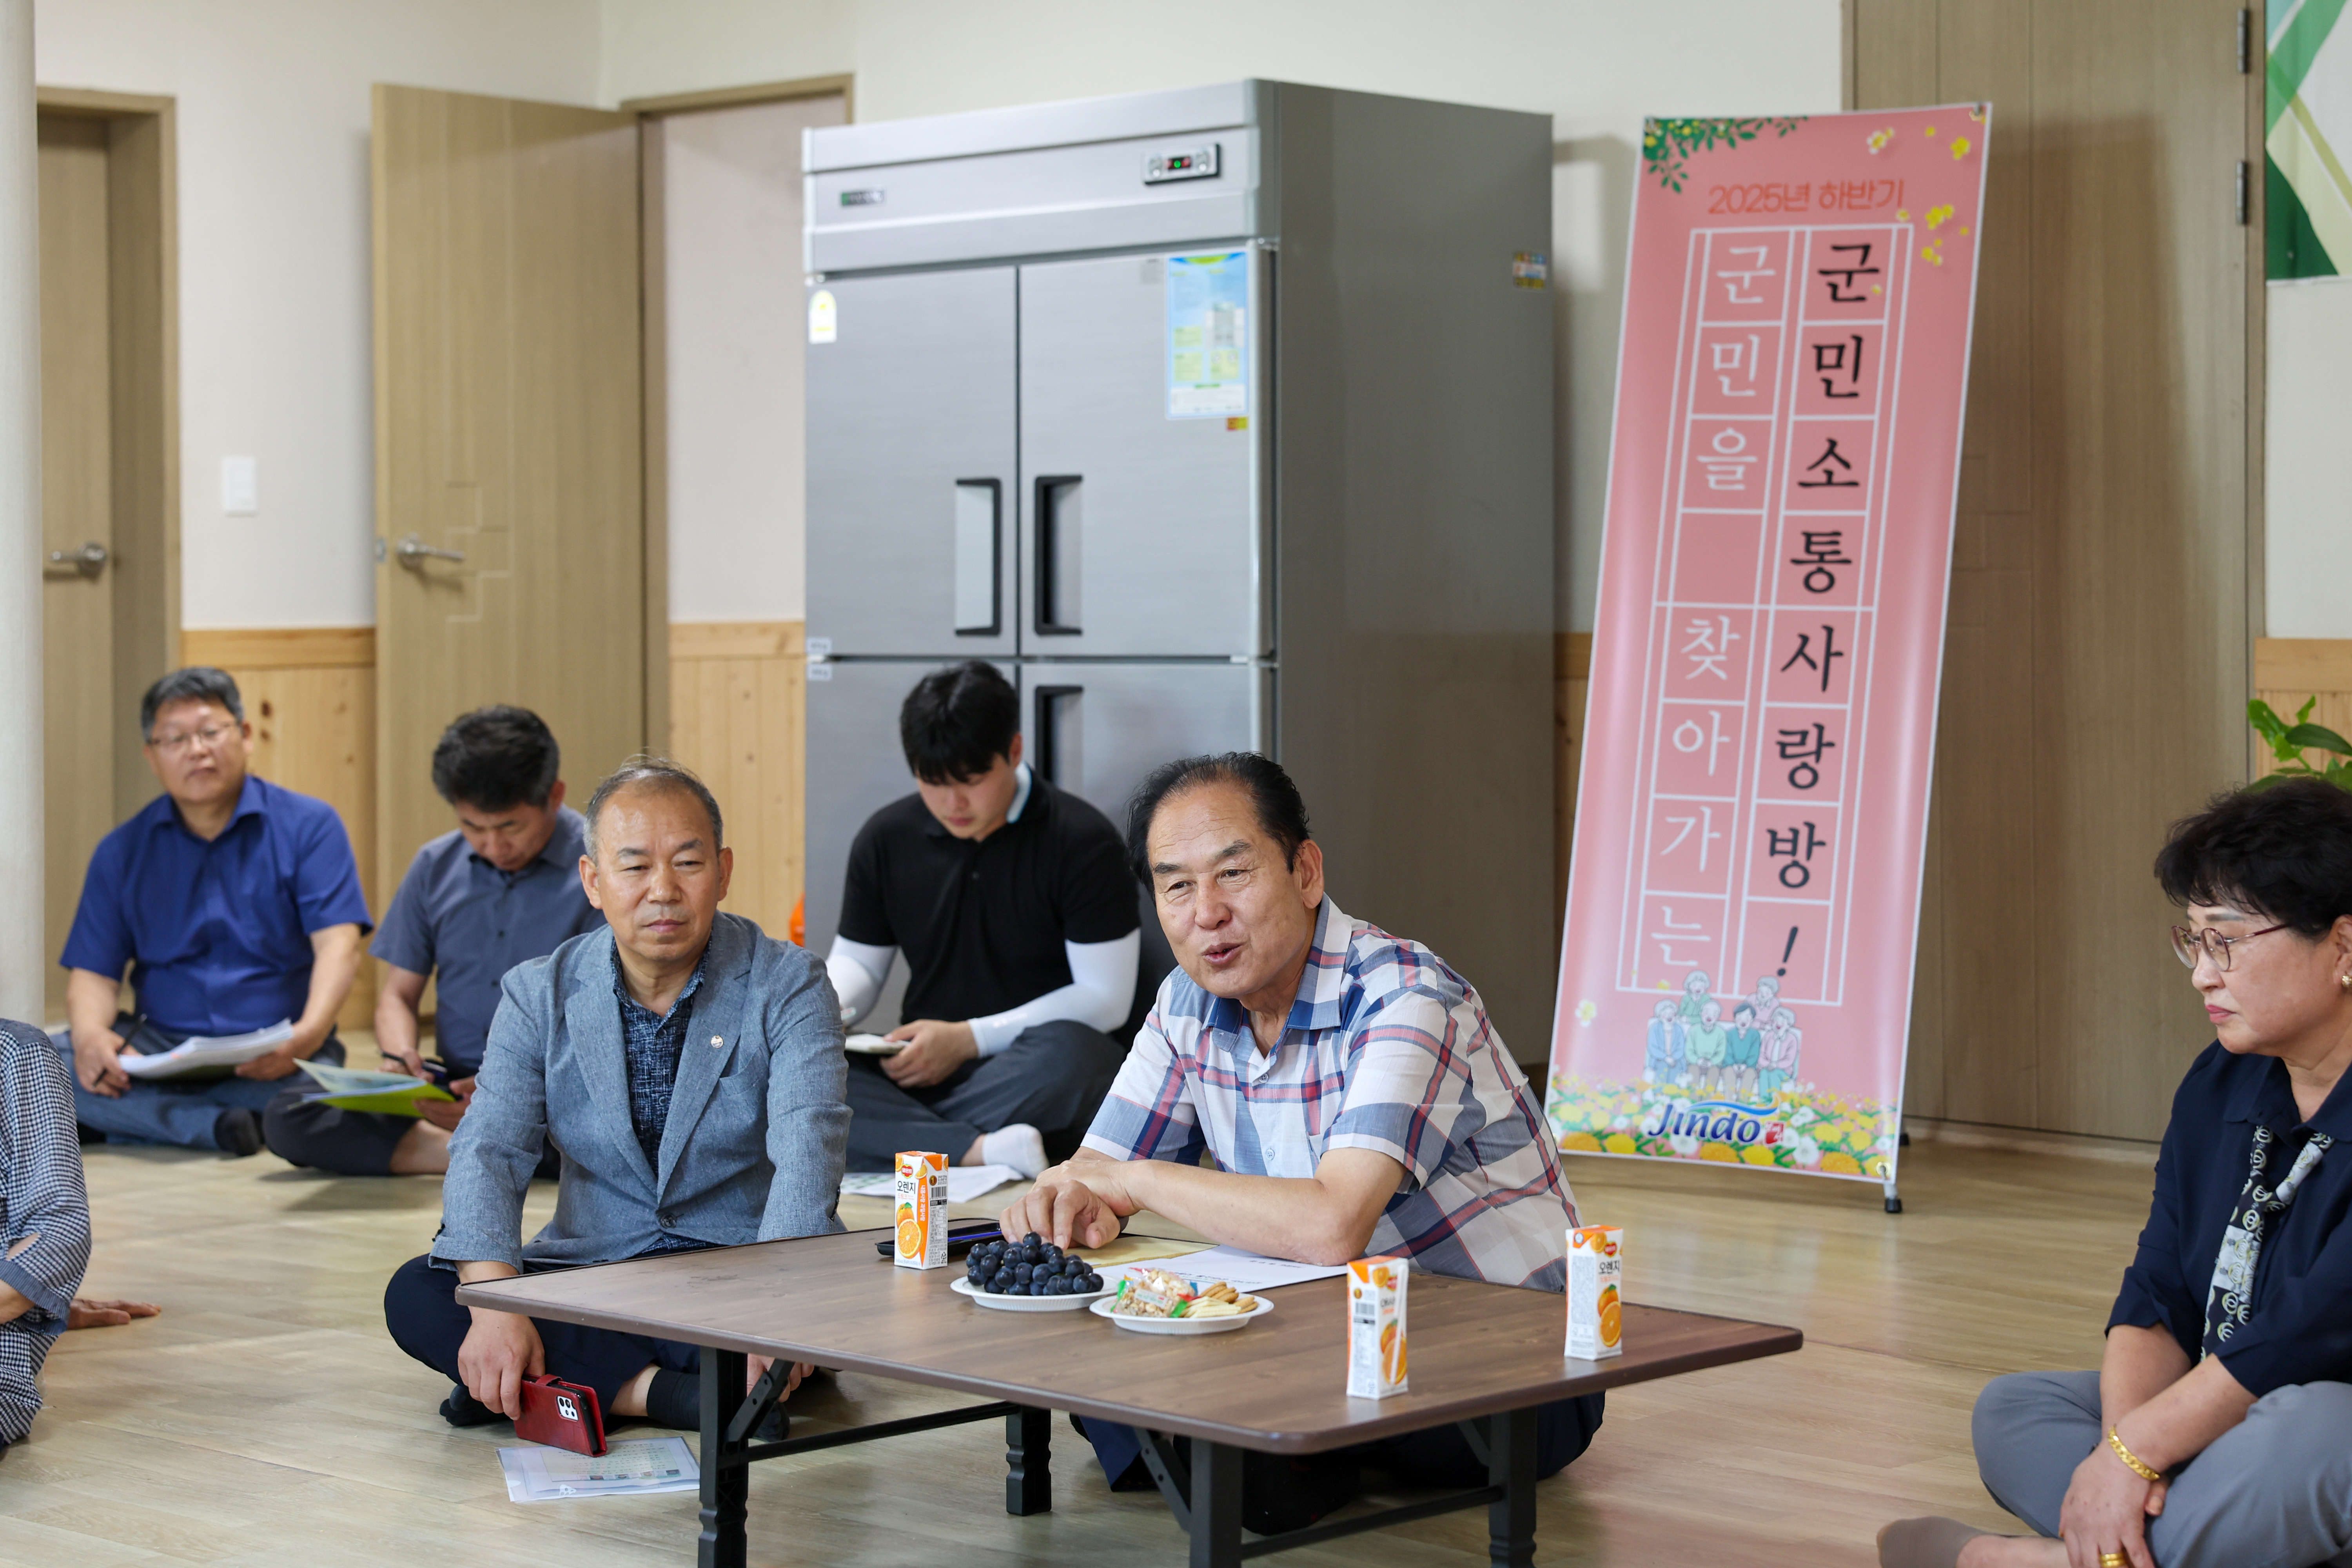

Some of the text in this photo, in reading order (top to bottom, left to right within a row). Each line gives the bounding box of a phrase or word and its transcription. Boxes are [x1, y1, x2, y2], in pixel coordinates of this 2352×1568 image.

[1708, 179, 1905, 215] 2025년 하반기
[1651, 245, 1776, 967] 군민을 찾아가는
[1648, 1104, 1760, 1143] Jindo
[897, 1181, 916, 1194] 오렌지
[1599, 1260, 1620, 1275] 오렌지
